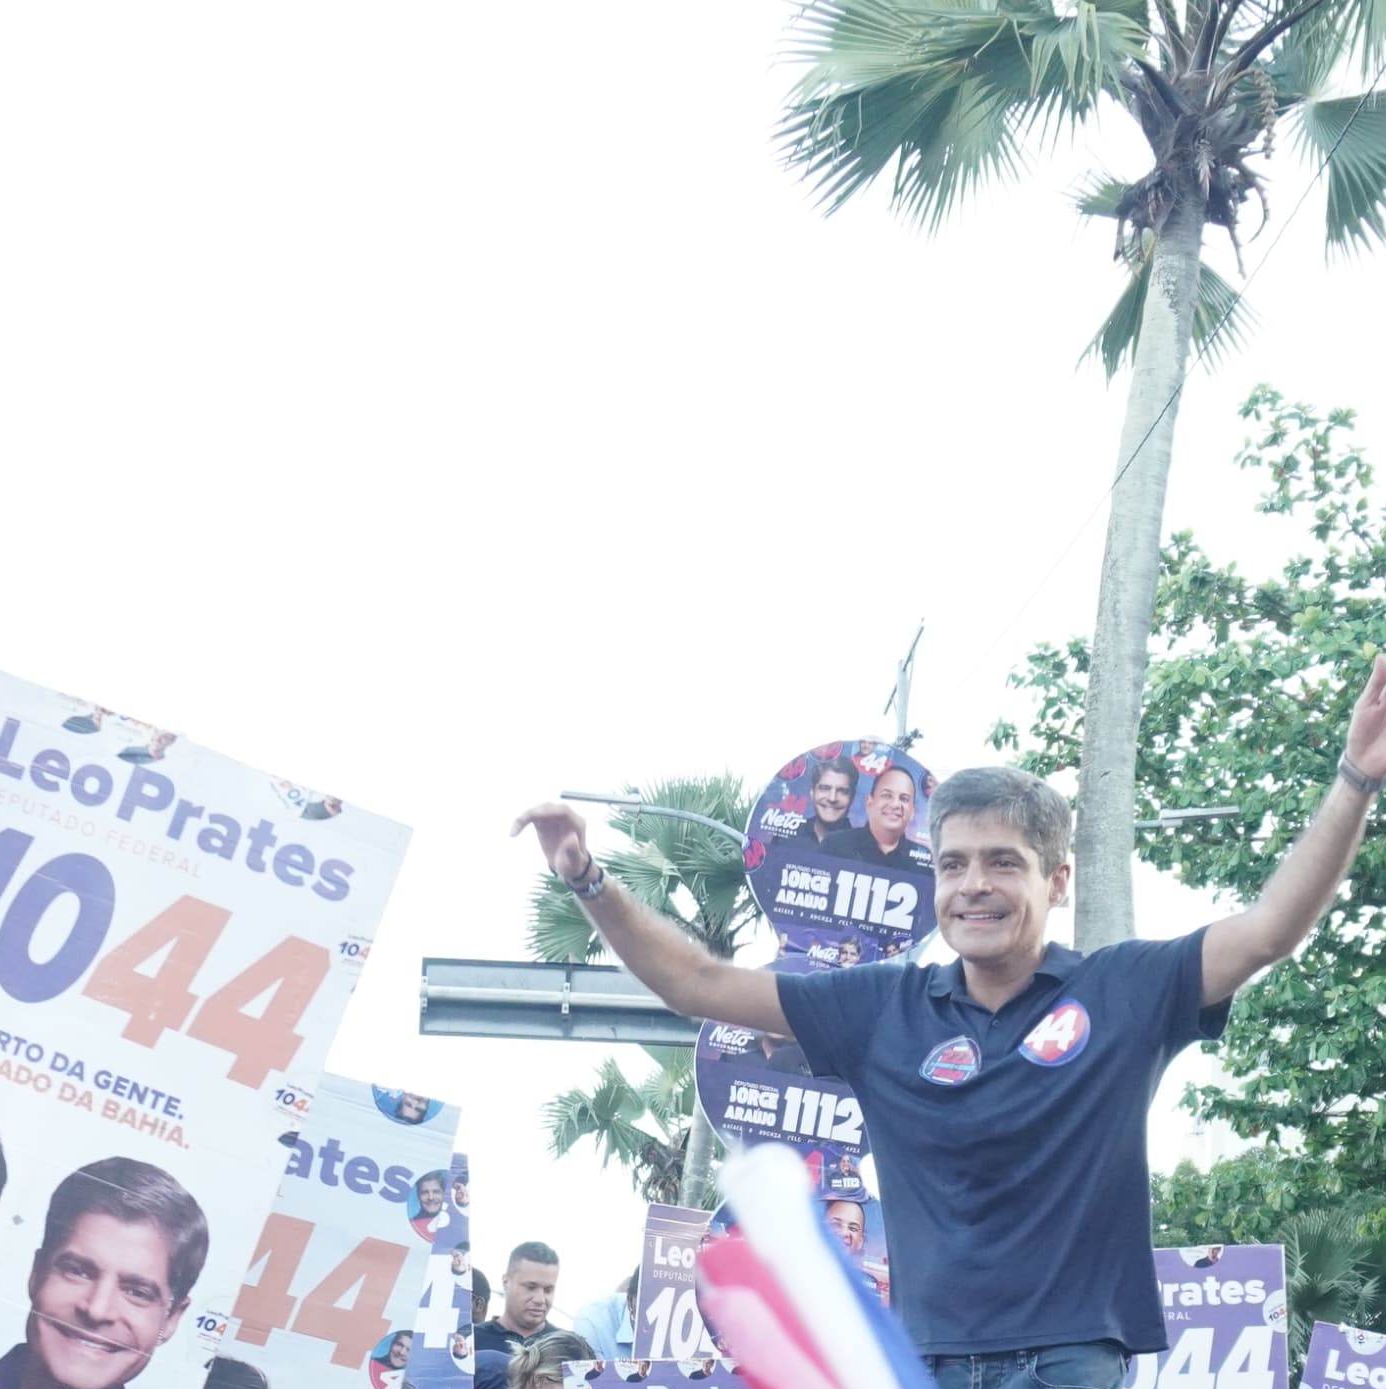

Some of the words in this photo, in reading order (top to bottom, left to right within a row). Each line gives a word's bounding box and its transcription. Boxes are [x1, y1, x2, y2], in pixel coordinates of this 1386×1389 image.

[761, 809, 807, 830] Neto
[105, 829, 201, 879] FEDERAL
[781, 868, 832, 895] JORGE
[833, 869, 918, 931] 1112
[709, 1026, 755, 1046] Neto
[1024, 1009, 1077, 1050] 44
[50, 1050, 86, 1081] DA
[93, 1067, 185, 1121] GENTE.
[275, 1088, 310, 1113] 104
[729, 1085, 779, 1110] JORGE
[57, 1080, 94, 1113] DA
[100, 1093, 191, 1151] BAHIA.
[724, 1105, 776, 1127] ARAÚJO
[782, 1086, 864, 1145] 1112
[654, 1236, 694, 1266] Leo
[653, 1270, 694, 1283] DEPUTADO
[1158, 1277, 1266, 1307] rates
